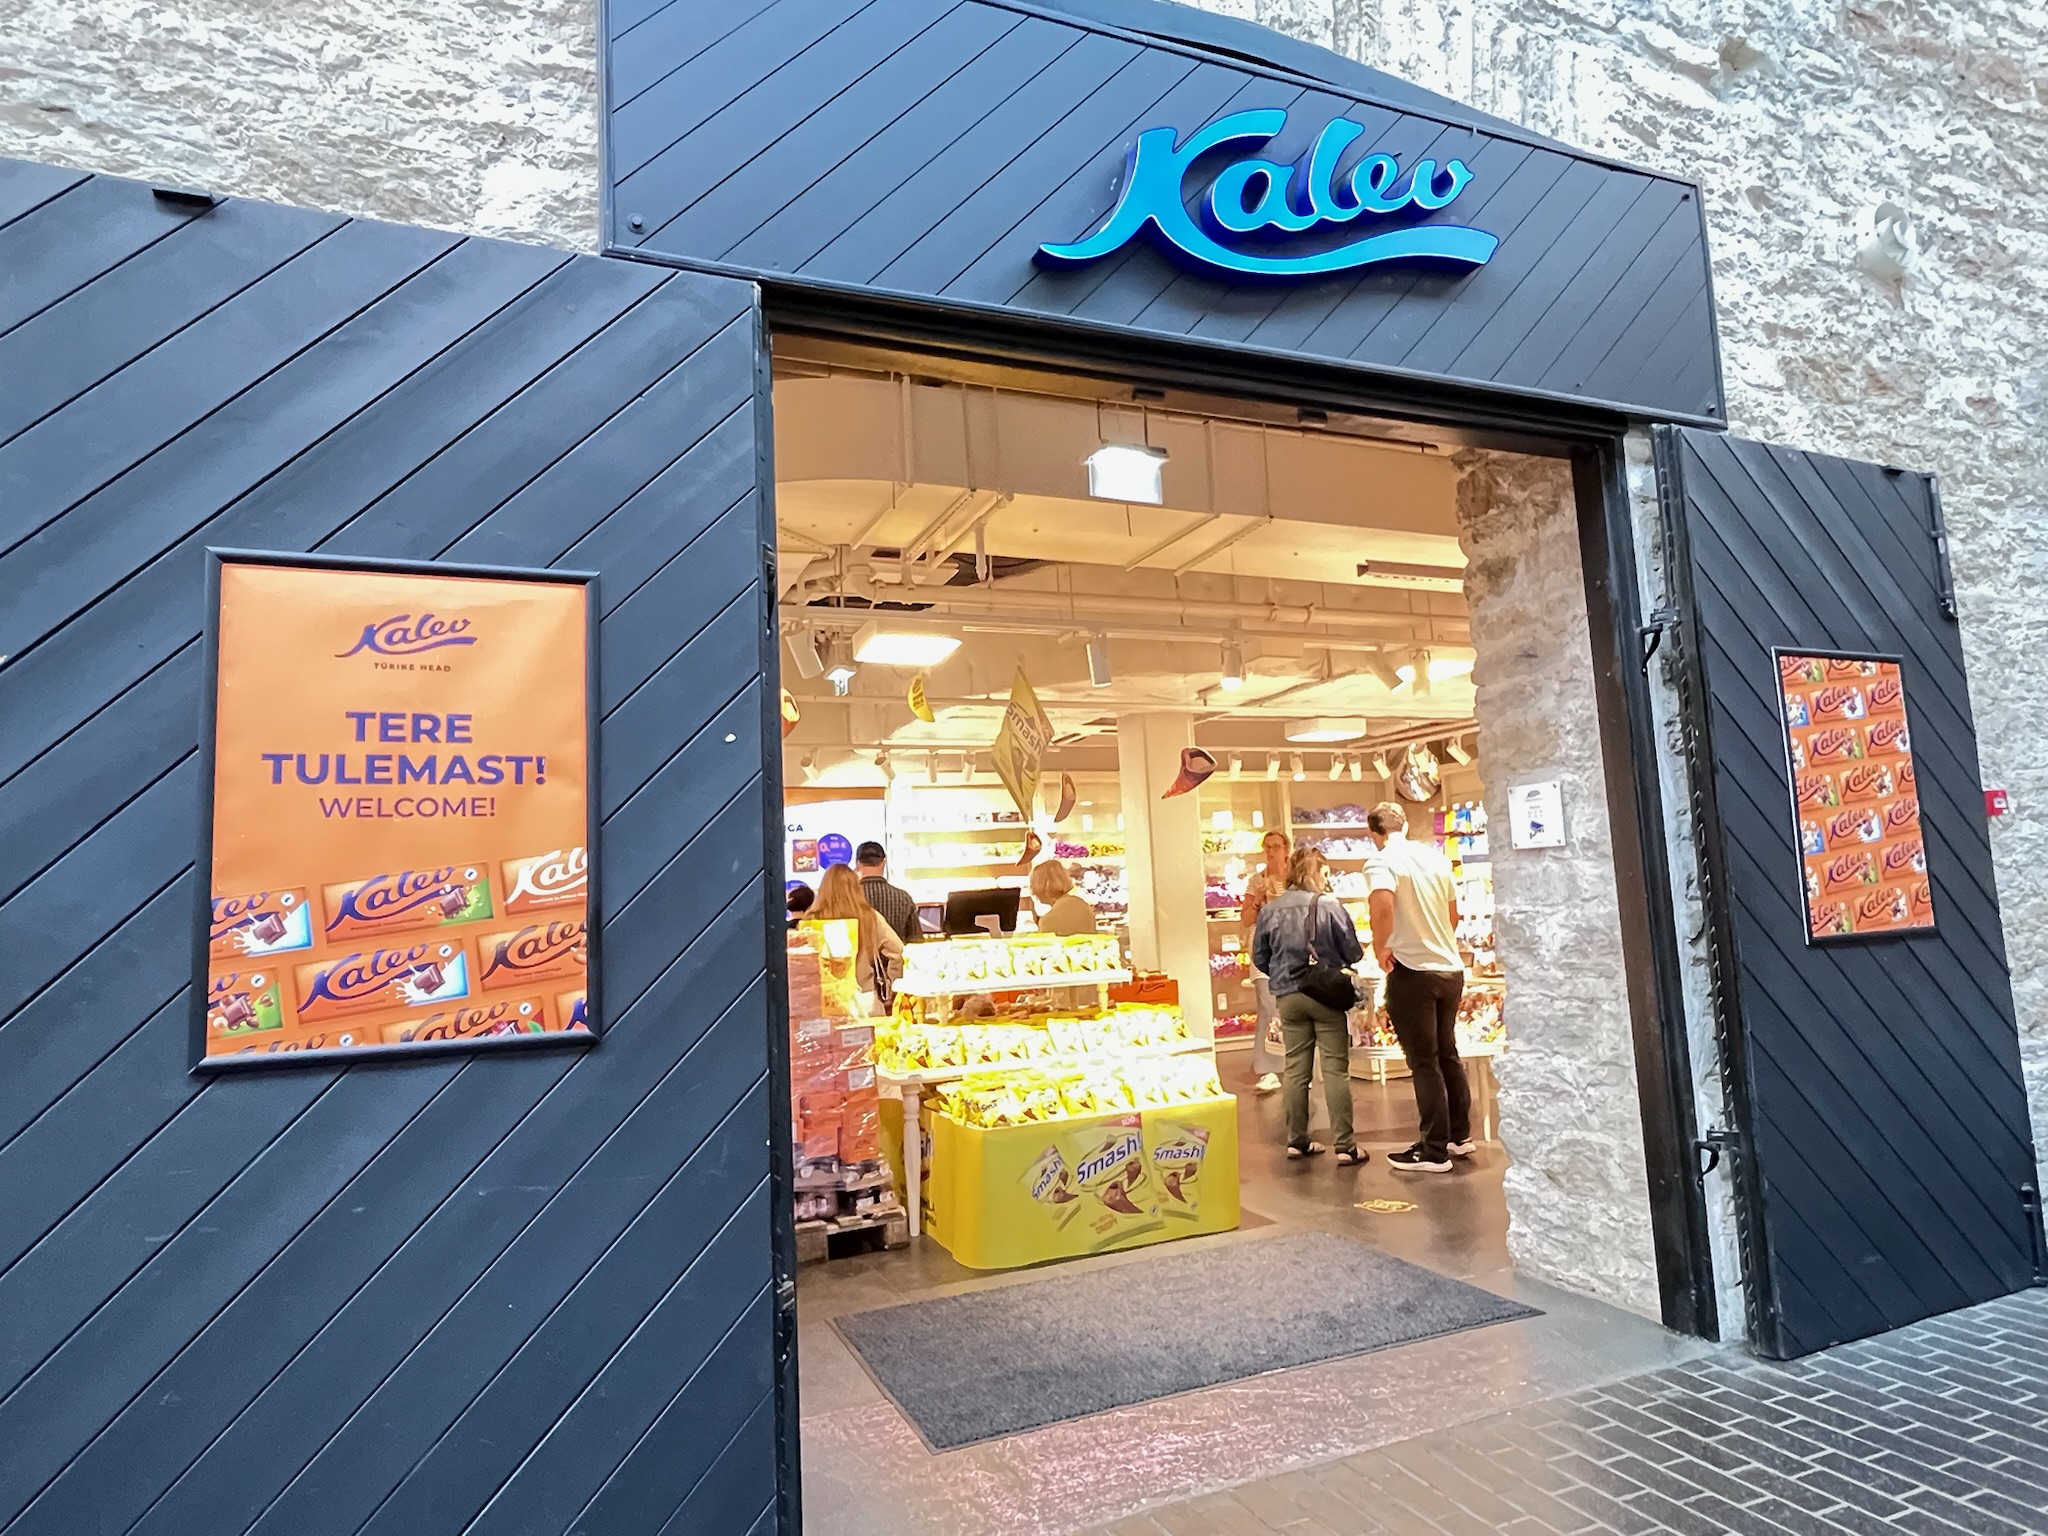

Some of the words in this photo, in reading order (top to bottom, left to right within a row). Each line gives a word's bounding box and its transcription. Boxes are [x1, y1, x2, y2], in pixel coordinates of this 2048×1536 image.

[1032, 108, 1499, 275] Kalev
[334, 613, 477, 658] Kalev
[420, 664, 451, 672] HEAD
[1812, 686, 1851, 718] Kalev
[345, 711, 473, 744] TERE
[1810, 728, 1849, 762] Kalev
[261, 752, 547, 785] TULEMAST!
[1842, 764, 1879, 798] Kalev
[318, 797, 496, 818] WELCOME!
[1829, 808, 1868, 844] Kalev
[1825, 852, 1866, 889] Kalev
[326, 866, 465, 932] Kalev
[1857, 888, 1897, 927] Kalev
[297, 944, 439, 1014] Kalev
[1077, 1131, 1142, 1184] Smash!
[1153, 1144, 1205, 1161] Smash!
